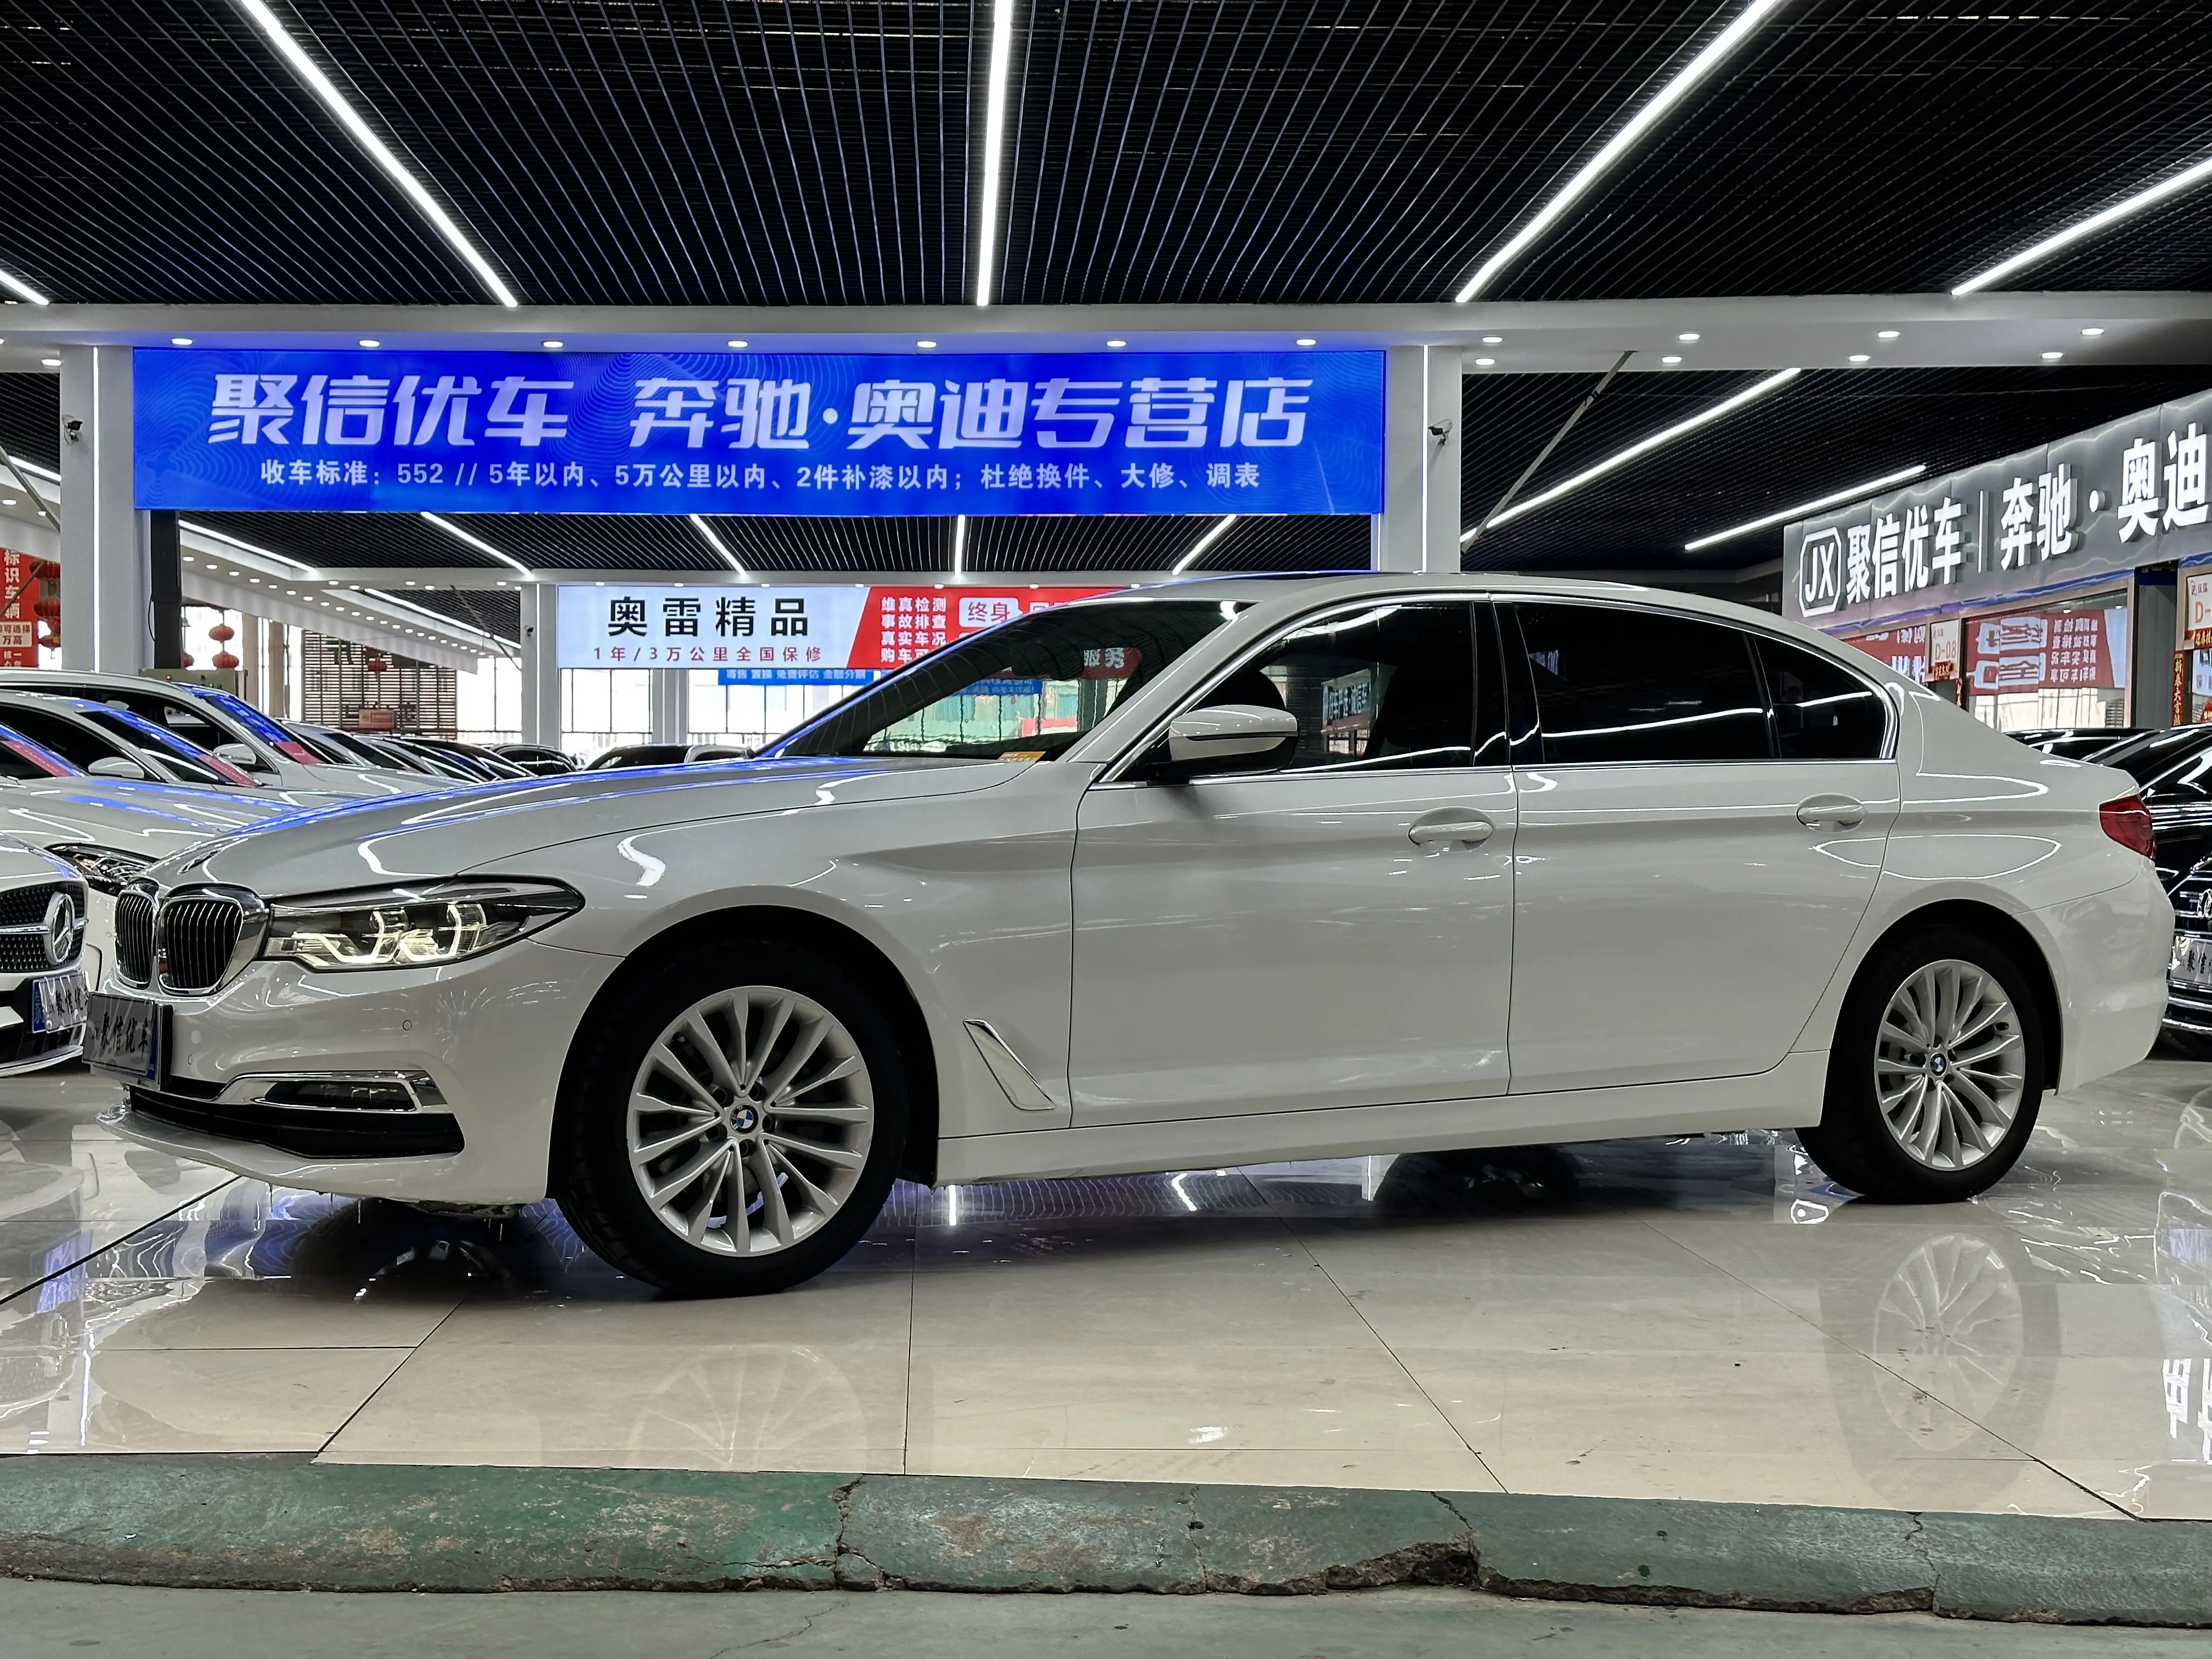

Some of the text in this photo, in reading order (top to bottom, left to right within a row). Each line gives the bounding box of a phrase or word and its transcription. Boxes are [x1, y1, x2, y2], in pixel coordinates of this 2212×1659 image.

[208, 374, 1313, 450] 聚信优车 奔驰·奥迪专营店
[2000, 421, 2209, 571] 奔驰·奥迪
[1803, 496, 1963, 605] JX 聚信优车
[881, 596, 946, 612] 维真检测
[968, 601, 1010, 622] 终身
[607, 596, 809, 637] 奥雷精品
[881, 614, 946, 629] 事故排查
[881, 631, 946, 646] 真实车况
[594, 646, 821, 662] 1年/3万公里全国保修
